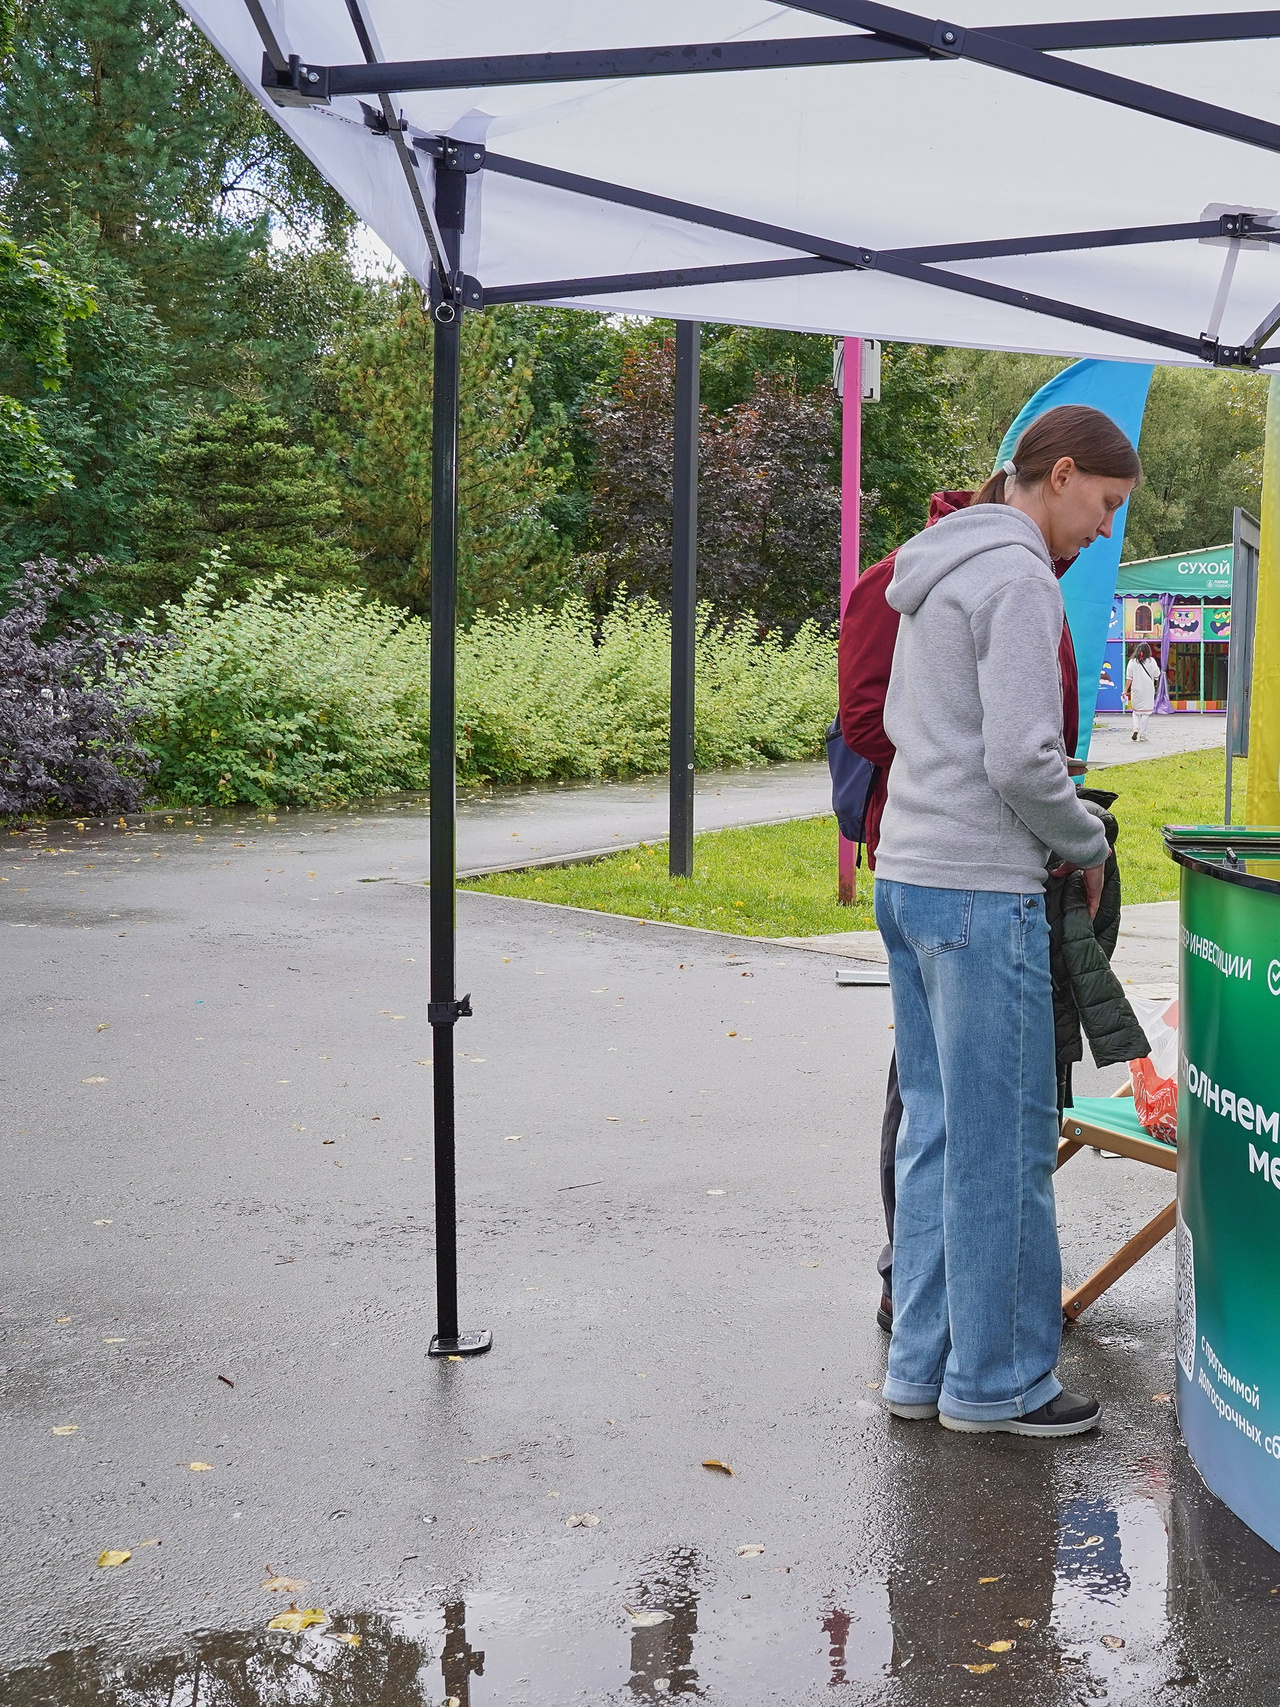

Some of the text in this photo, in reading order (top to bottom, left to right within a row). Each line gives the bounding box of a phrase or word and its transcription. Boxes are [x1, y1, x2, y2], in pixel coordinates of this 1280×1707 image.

[1177, 559, 1230, 575] СУХОЙ
[1181, 1049, 1280, 1144] полняем
[1197, 1366, 1262, 1447] долгосрочных
[1205, 1341, 1260, 1411] программой
